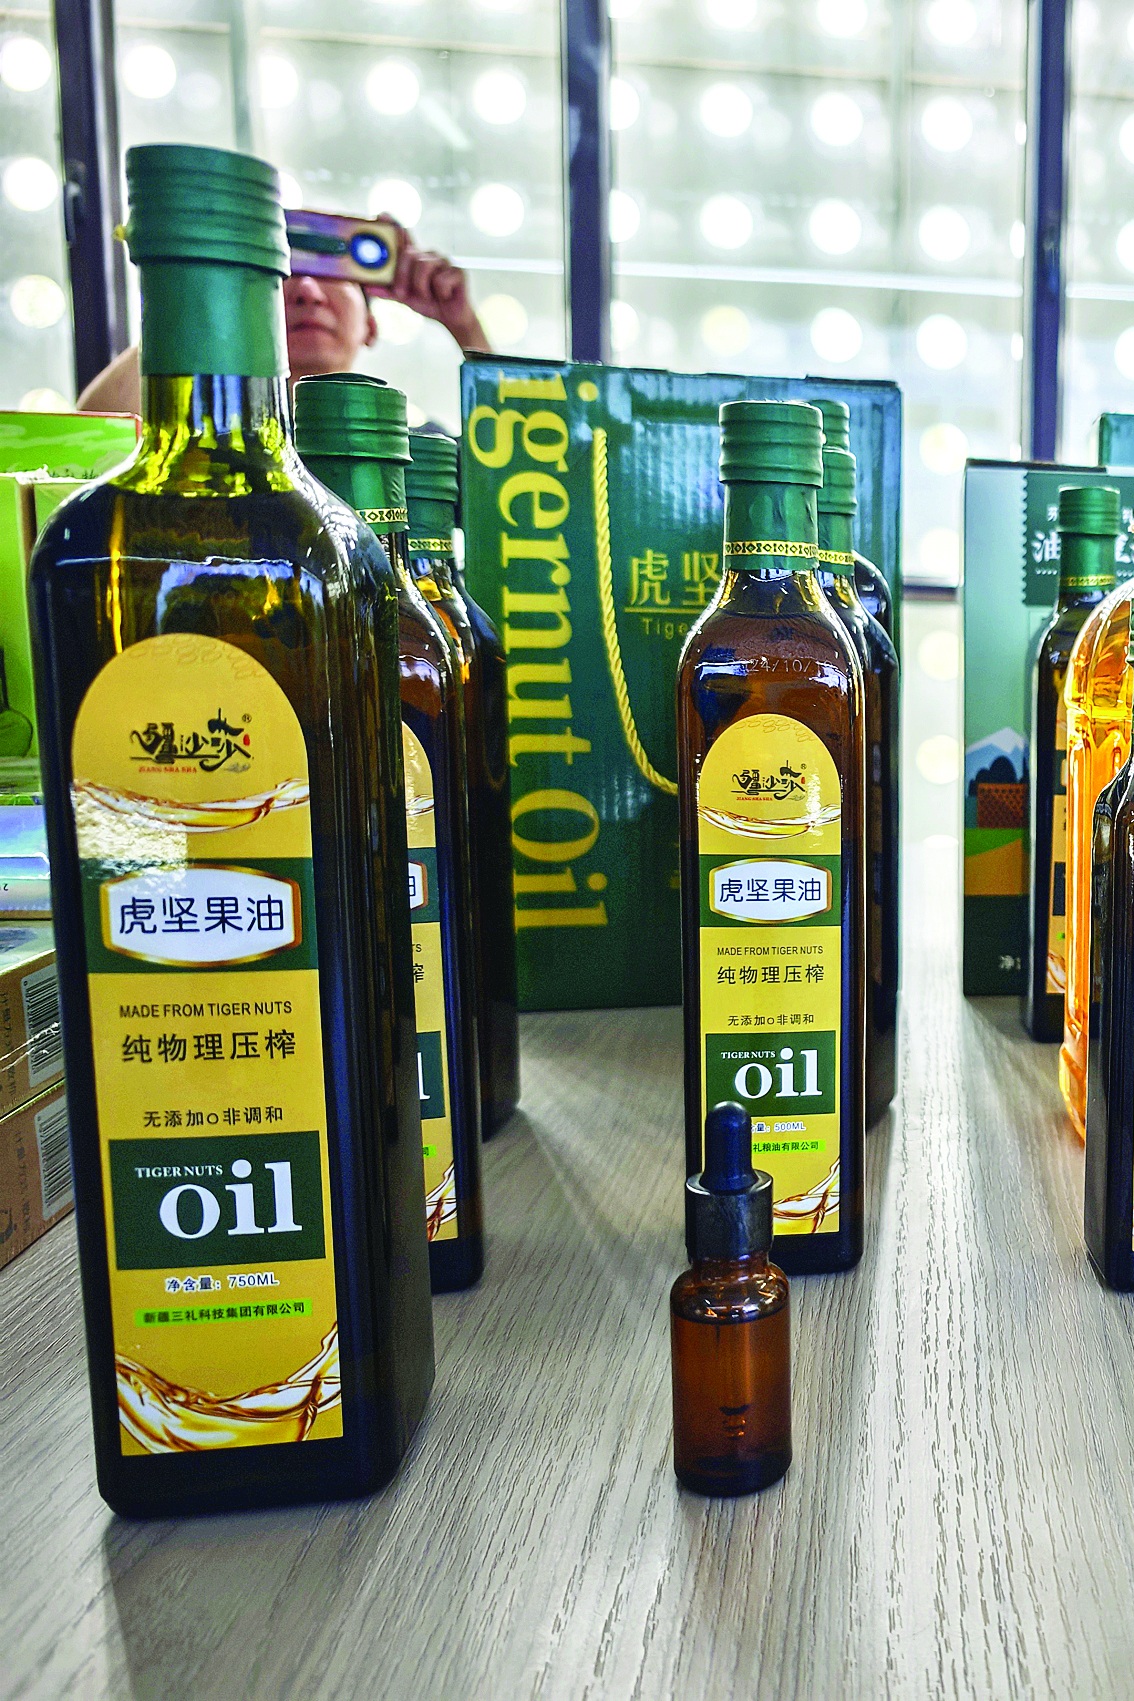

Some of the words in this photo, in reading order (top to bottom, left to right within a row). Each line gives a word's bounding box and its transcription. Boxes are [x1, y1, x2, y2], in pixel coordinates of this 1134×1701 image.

[719, 878, 822, 903] 虎坚果油
[119, 894, 284, 935] 虎坚果油
[717, 947, 742, 956] MADE
[744, 947, 770, 956] FROM
[771, 946, 798, 955] TIGER
[800, 945, 824, 954] NUTS
[717, 964, 825, 985] 纯物理压榨
[119, 1004, 160, 1019] MADE
[163, 1003, 204, 1018] FROM
[206, 1002, 252, 1017] TIGER
[255, 1001, 292, 1016] NUTS
[121, 1029, 296, 1064] 纯物理压榨
[720, 1051, 750, 1060] TIGER
[750, 1051, 776, 1059] NUTS
[734, 1047, 823, 1100] oil
[134, 1165, 182, 1179] TIGER
[183, 1164, 223, 1178] NUTS
[159, 1159, 303, 1241] oil
[143, 1302, 305, 1323] 新疆三礼科技集团有限公司
